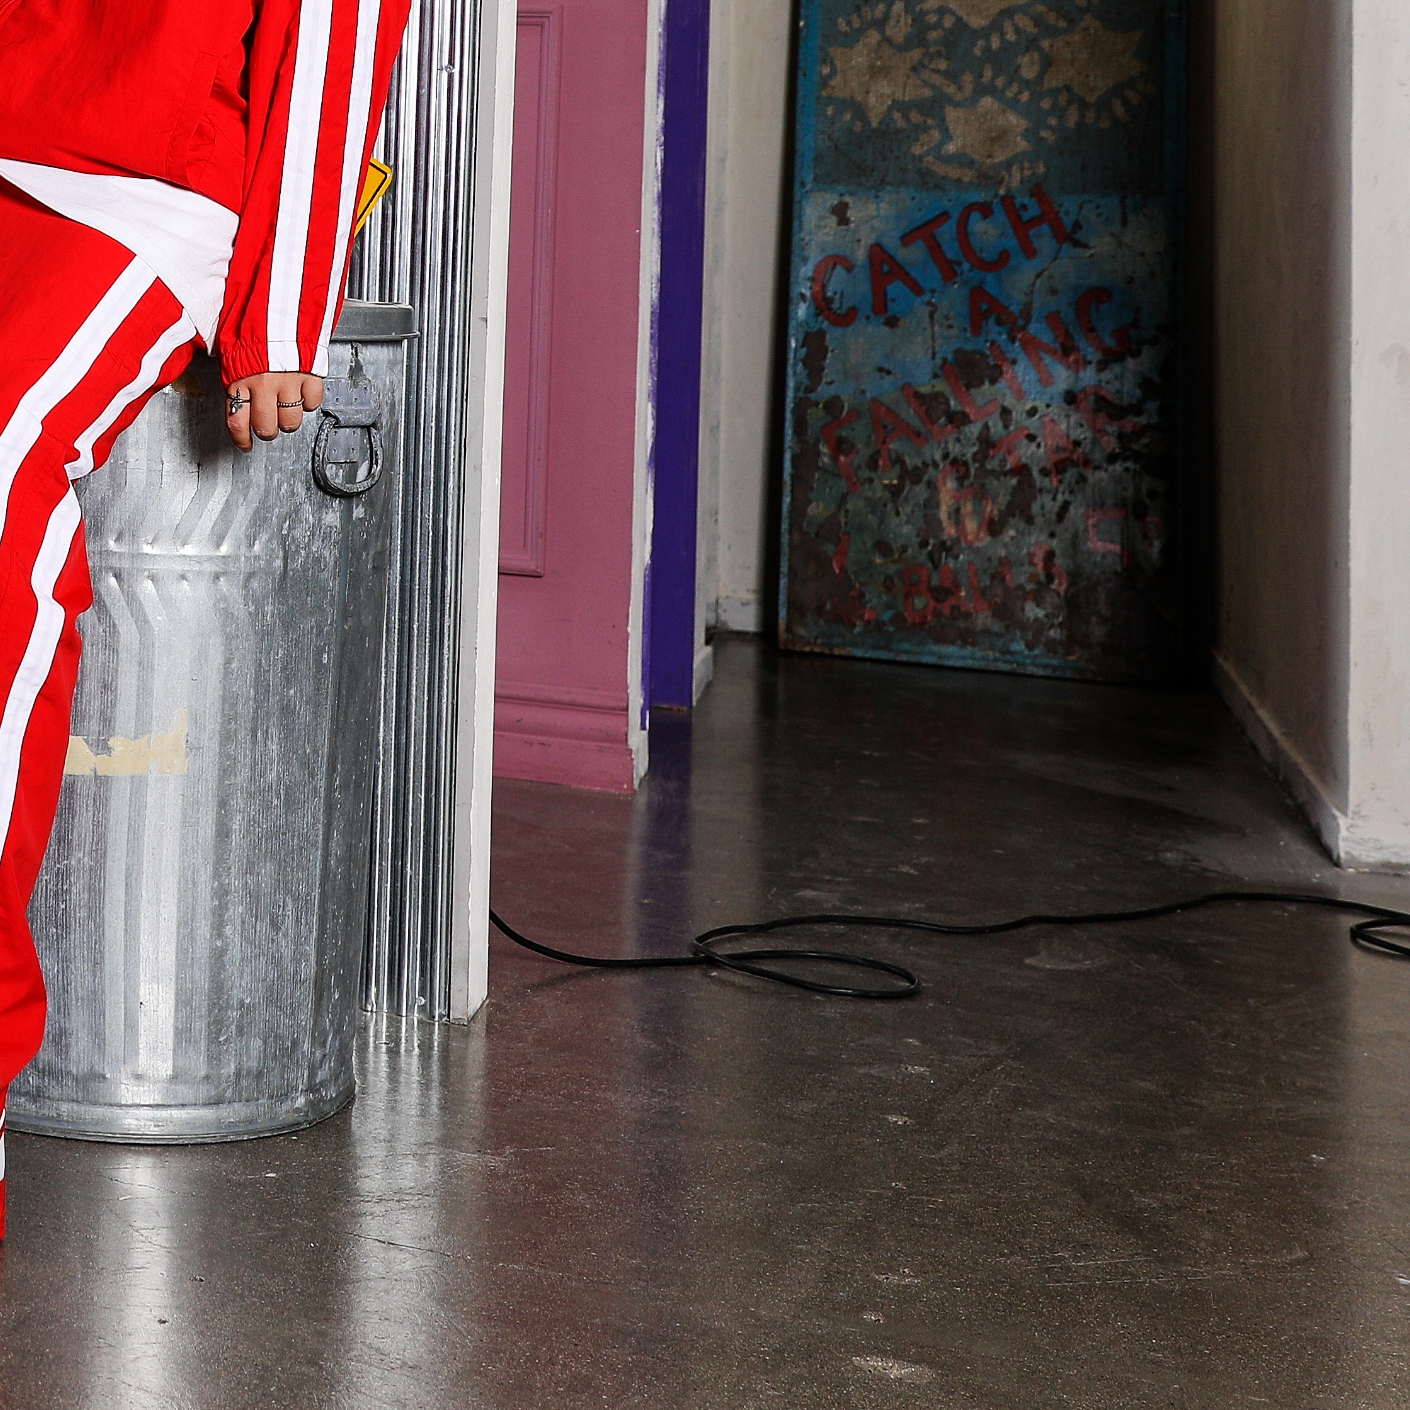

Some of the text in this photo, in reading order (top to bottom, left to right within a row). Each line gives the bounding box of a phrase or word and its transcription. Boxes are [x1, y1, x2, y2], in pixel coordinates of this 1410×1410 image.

[810, 184, 1070, 328] CATCH
[969, 284, 1018, 338] A
[819, 286, 1137, 492] FALLING
